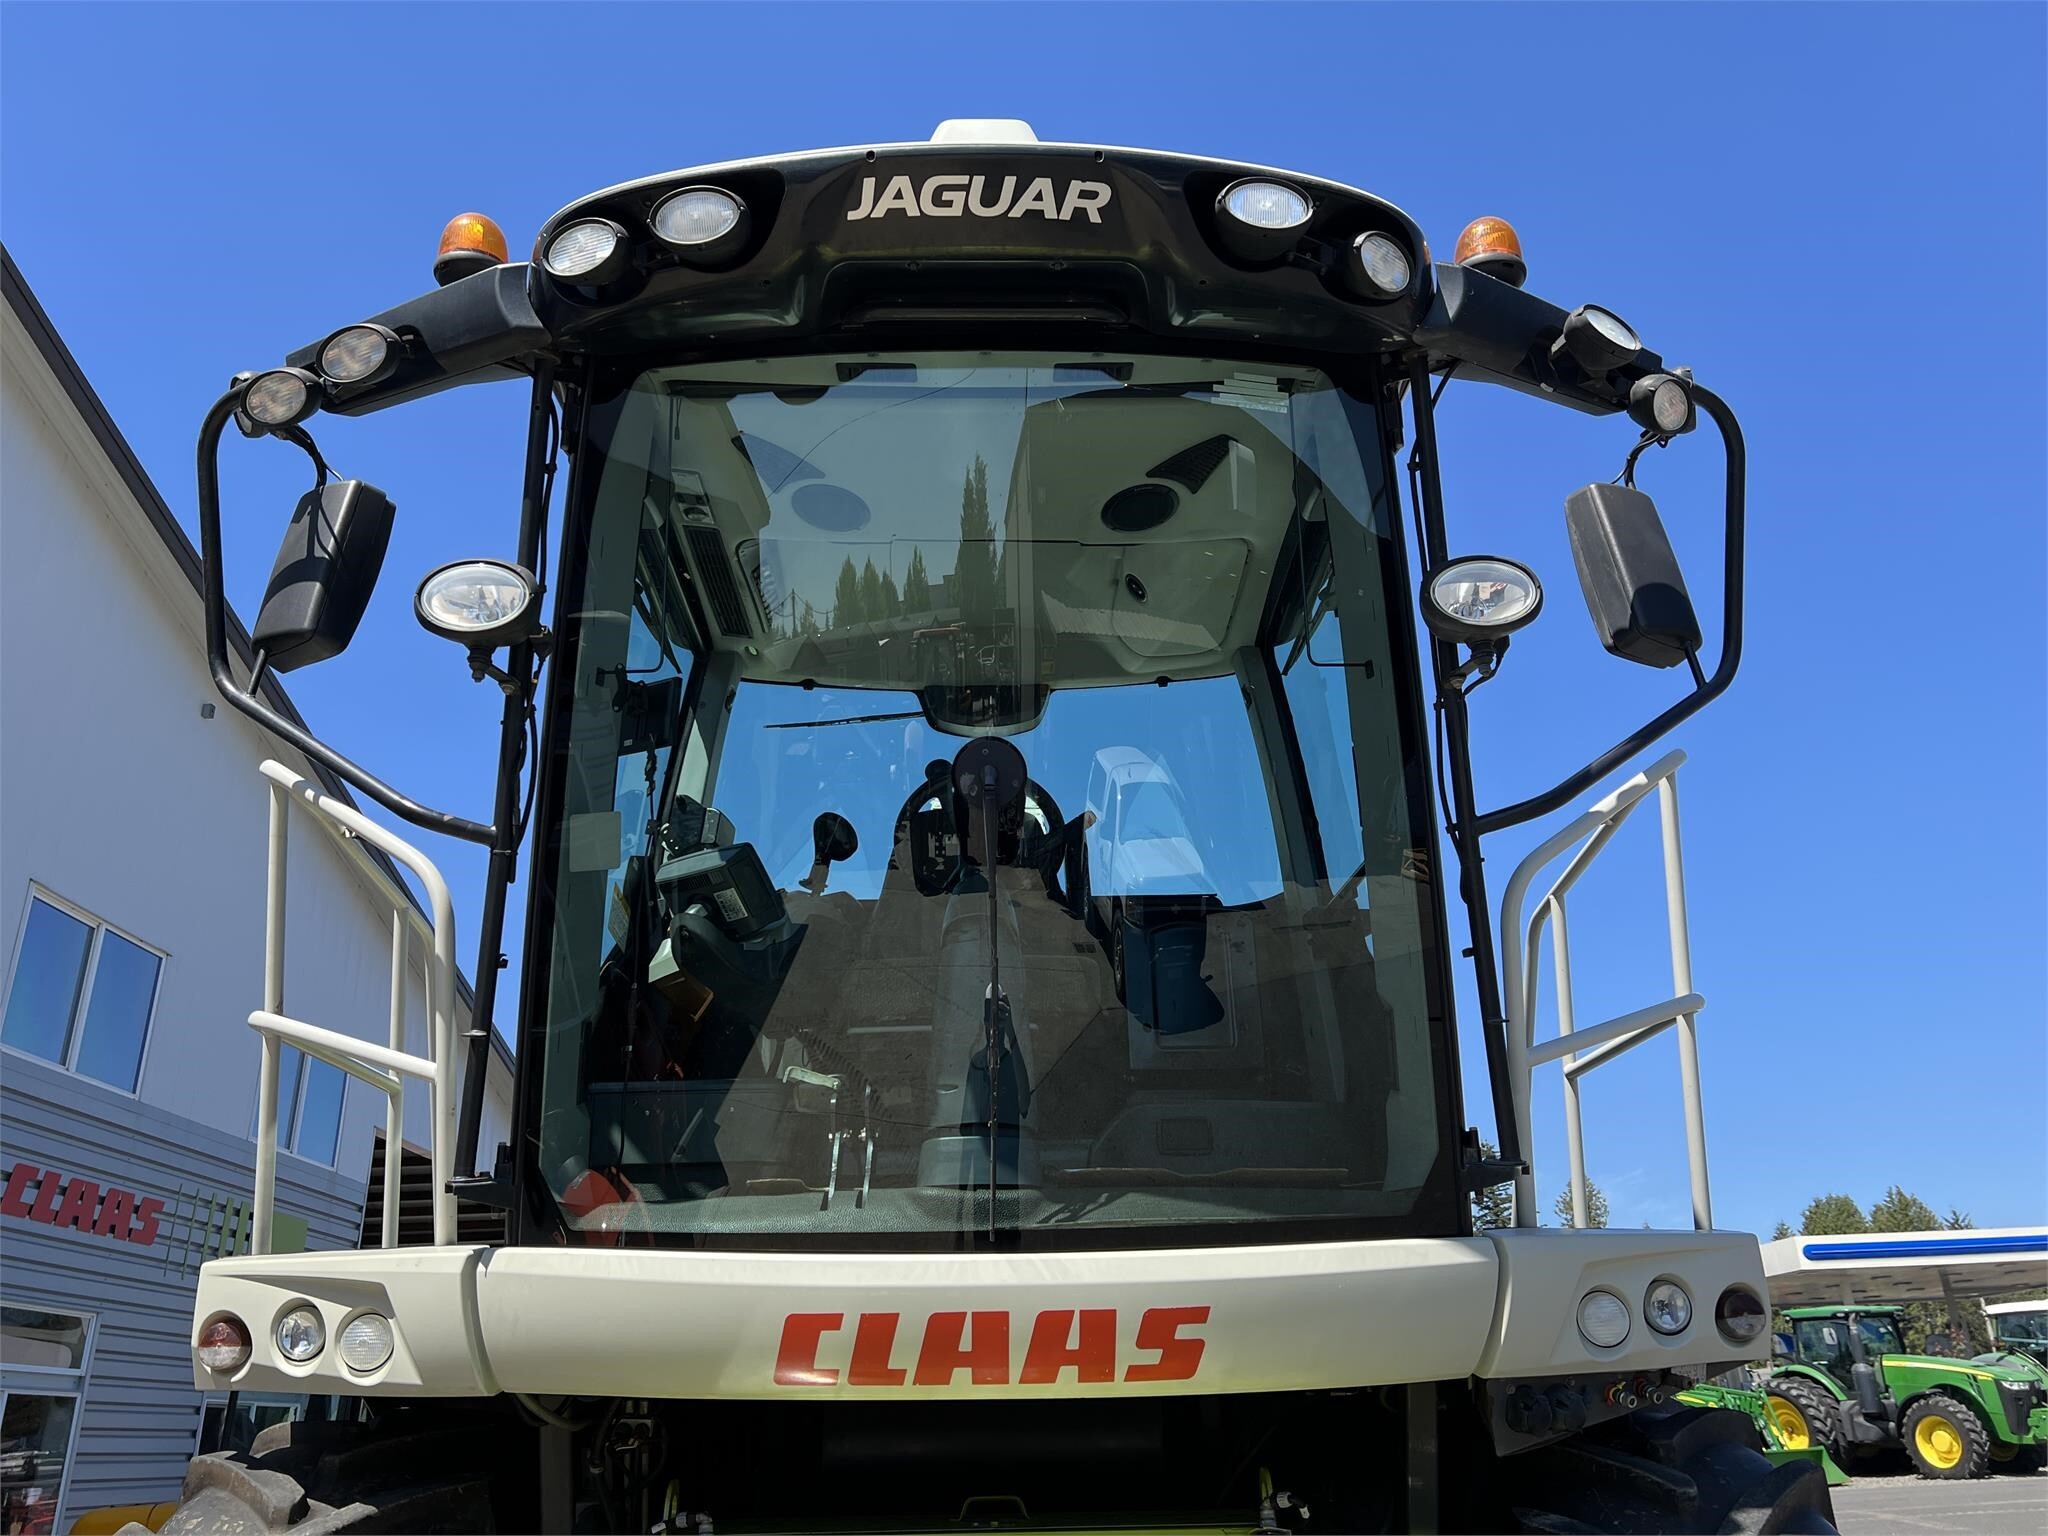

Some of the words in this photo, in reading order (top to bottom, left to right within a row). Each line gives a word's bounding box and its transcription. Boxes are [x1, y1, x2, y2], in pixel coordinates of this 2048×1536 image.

[847, 175, 1112, 223] JAGUAR
[0, 1163, 165, 1246] CLAAS
[773, 1306, 1211, 1386] CLAAS
